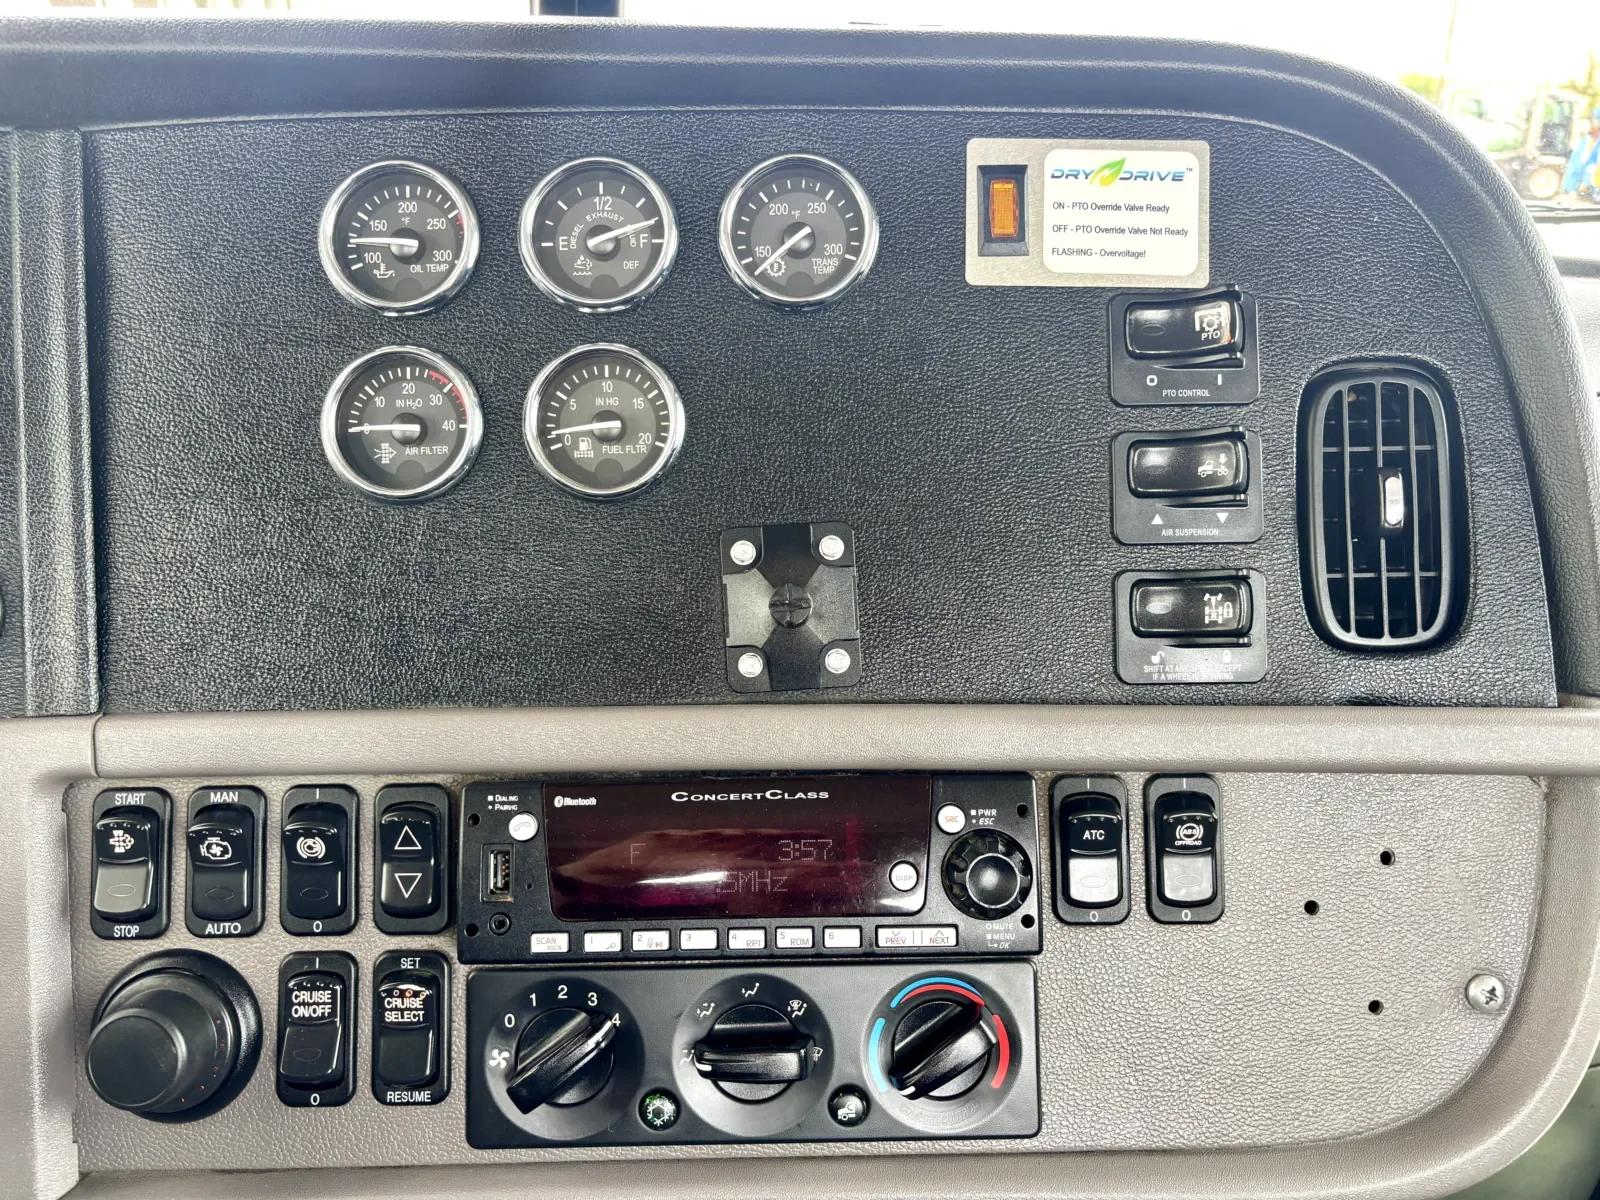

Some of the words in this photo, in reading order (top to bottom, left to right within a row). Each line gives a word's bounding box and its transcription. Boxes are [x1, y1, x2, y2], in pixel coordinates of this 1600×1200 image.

[1050, 168, 1095, 180] DRY
[1118, 170, 1185, 182] DRIVE
[398, 202, 417, 213] 200
[594, 196, 613, 211] 1/2
[769, 203, 788, 215] 200
[807, 202, 827, 214] 250
[1052, 202, 1065, 210] ON
[1072, 202, 1089, 211] PTO
[1090, 202, 1122, 212] Override
[1123, 203, 1144, 212] Valve
[1146, 203, 1170, 214] Ready
[585, 212, 625, 223] EXHAUST
[369, 220, 387, 232] 150
[426, 218, 446, 230] 250
[569, 223, 584, 249] DIESEL
[1052, 225, 1069, 233] OFF
[1075, 225, 1093, 234] PTO
[1094, 225, 1126, 235] Override
[1127, 226, 1148, 235] Valve
[1150, 226, 1163, 236] Not
[1164, 227, 1189, 238] Ready
[559, 236, 569, 251] E
[640, 233, 649, 248] F
[754, 246, 772, 257] 150
[823, 243, 843, 255] 300
[1051, 248, 1093, 257] FLASHING
[1099, 249, 1146, 259] Overvoltage!
[364, 252, 382, 264] 100
[432, 250, 452, 261] 300
[623, 261, 639, 270] DEF
[811, 258, 839, 266] TRANS
[410, 265, 423, 273] OIL
[426, 264, 449, 273] TEMP
[813, 265, 835, 274] TEMP
[1201, 331, 1221, 340] PTO
[402, 383, 416, 394] 20
[601, 381, 613, 393] 10
[1162, 389, 1177, 397] PTO
[1177, 389, 1211, 397] CONTROL
[375, 396, 385, 408] 10
[395, 399, 405, 408] IN
[429, 394, 443, 406] 30
[569, 399, 577, 411] 5
[595, 397, 604, 406] IN
[606, 397, 620, 406] HG
[632, 398, 645, 409] 15
[442, 419, 455, 431] 40
[564, 434, 572, 446] 0
[638, 433, 651, 444] 20
[404, 446, 420, 455] AIR
[420, 446, 449, 455] FILTER
[602, 446, 624, 454] FUEL
[625, 445, 647, 454] FLTR
[1161, 529, 1174, 537] AIR
[1175, 529, 1219, 537] SUSPENSION
[1143, 665, 1164, 673] SHIFT
[1152, 672, 1158, 680] IF
[1160, 672, 1166, 680] A
[114, 793, 146, 805] START
[210, 792, 239, 802] MAN
[563, 796, 597, 806] Bluetooth
[944, 815, 959, 823] SRC
[977, 809, 997, 817] PWR
[1083, 830, 1105, 840] ATC
[777, 839, 833, 861] 3:57
[113, 925, 140, 937] STOP
[205, 922, 241, 935] AUTO
[535, 937, 557, 945] SCAN
[686, 933, 692, 942] 3
[885, 937, 907, 945] PREV
[992, 933, 1016, 941] MENU
[400, 957, 421, 969] SET
[292, 991, 331, 1003] CRUISE
[557, 984, 568, 999] 2
[384, 997, 424, 1009] CRUISE
[529, 992, 537, 1007] 1
[587, 992, 598, 1006] 3
[291, 1005, 332, 1018] ON/OFF
[384, 1010, 424, 1022] SELECT
[504, 1013, 515, 1028] 0
[611, 1012, 621, 1026] 4
[386, 1091, 431, 1103] RESUME
